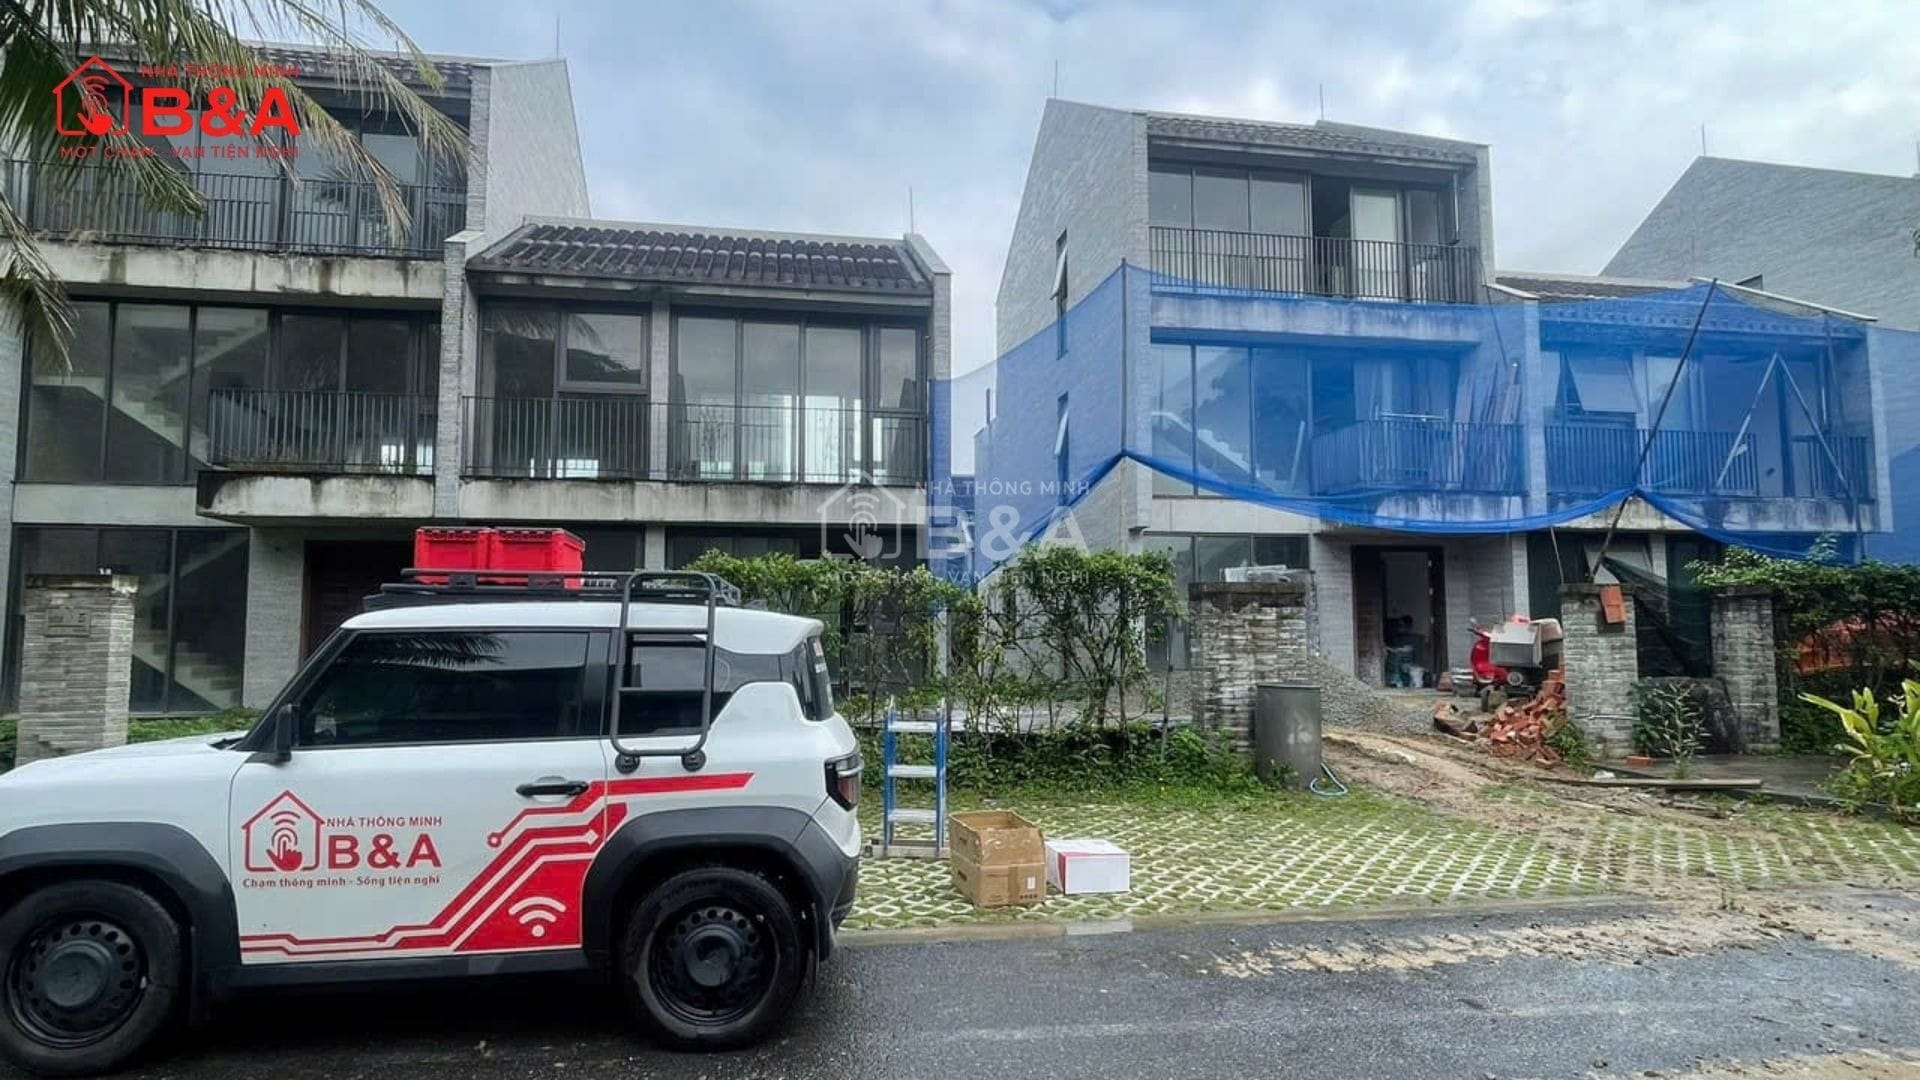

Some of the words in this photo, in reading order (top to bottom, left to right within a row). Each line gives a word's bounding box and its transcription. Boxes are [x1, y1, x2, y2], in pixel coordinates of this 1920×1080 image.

[359, 816, 406, 827] THÔNG
[409, 816, 442, 826] MINH
[328, 833, 442, 869] B&A
[279, 878, 313, 888] thông
[316, 877, 346, 886] minh
[413, 876, 440, 887] nghi
